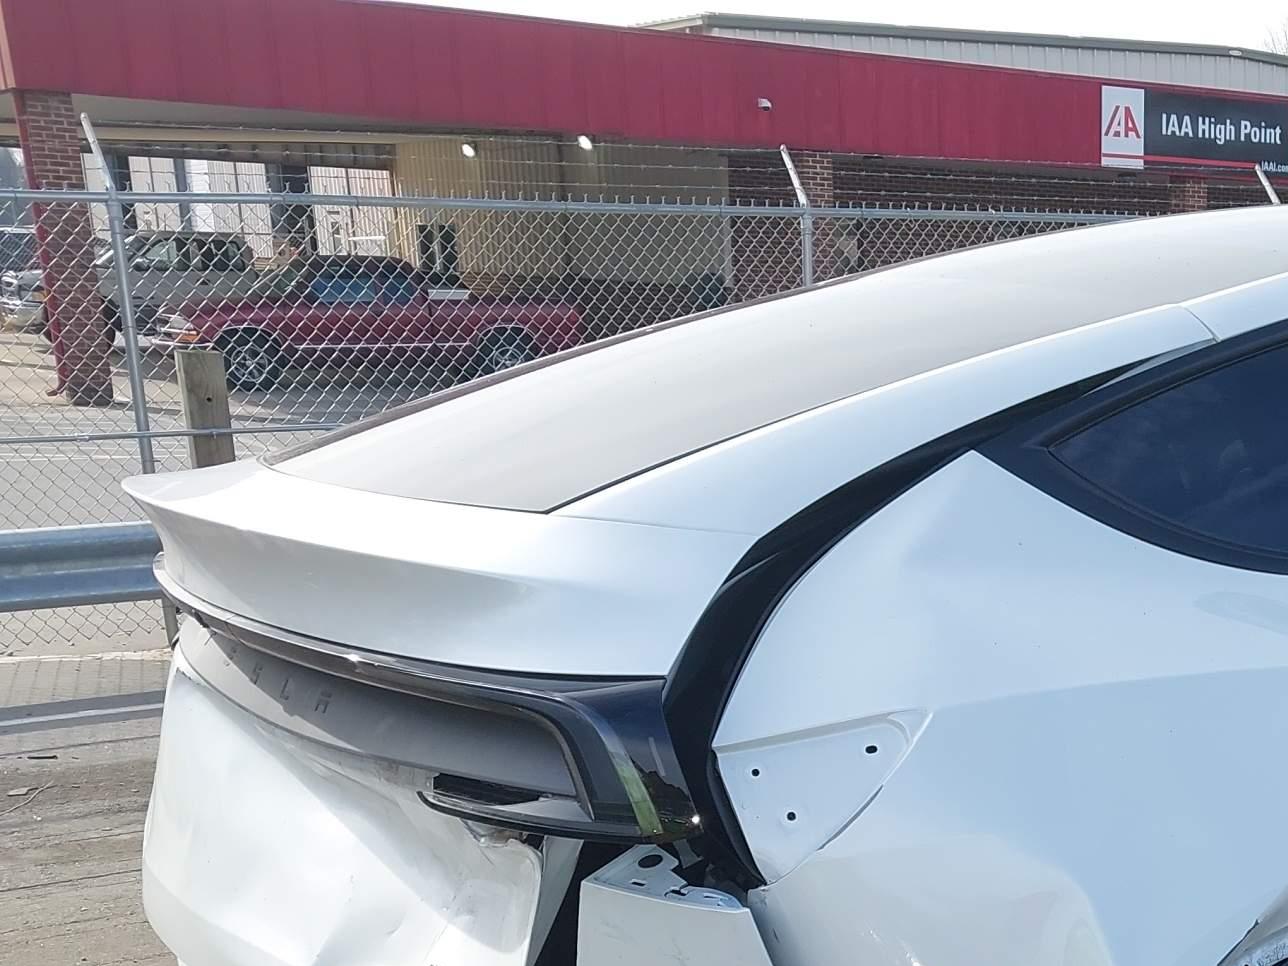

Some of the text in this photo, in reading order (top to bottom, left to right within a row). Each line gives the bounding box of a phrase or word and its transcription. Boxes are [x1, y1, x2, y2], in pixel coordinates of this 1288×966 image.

[1161, 112, 1282, 145] IAA High Point
